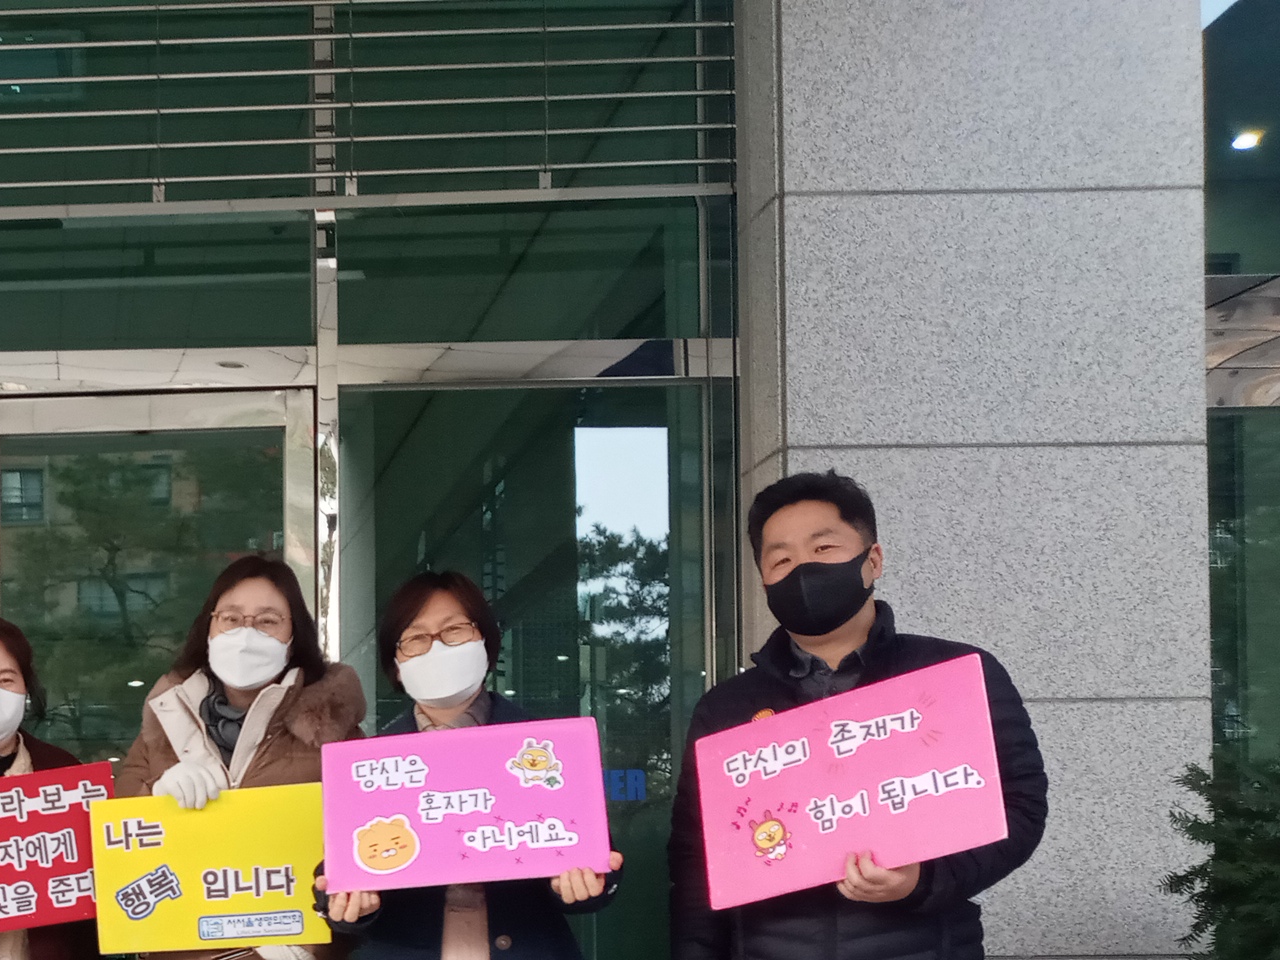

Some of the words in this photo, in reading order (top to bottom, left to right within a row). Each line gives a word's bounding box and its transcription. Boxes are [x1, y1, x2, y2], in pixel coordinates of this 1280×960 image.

[725, 740, 808, 784] 당신의
[829, 710, 921, 755] 존재가
[355, 758, 426, 789] 당신은
[604, 769, 646, 801] ER
[420, 791, 493, 821] 혼자가
[808, 792, 867, 832] 힘이
[879, 766, 983, 812] 됩니다.
[104, 819, 163, 850] 나는
[467, 822, 574, 849] 아니에요.
[118, 868, 179, 917] 행복
[202, 866, 296, 900] 입니다
